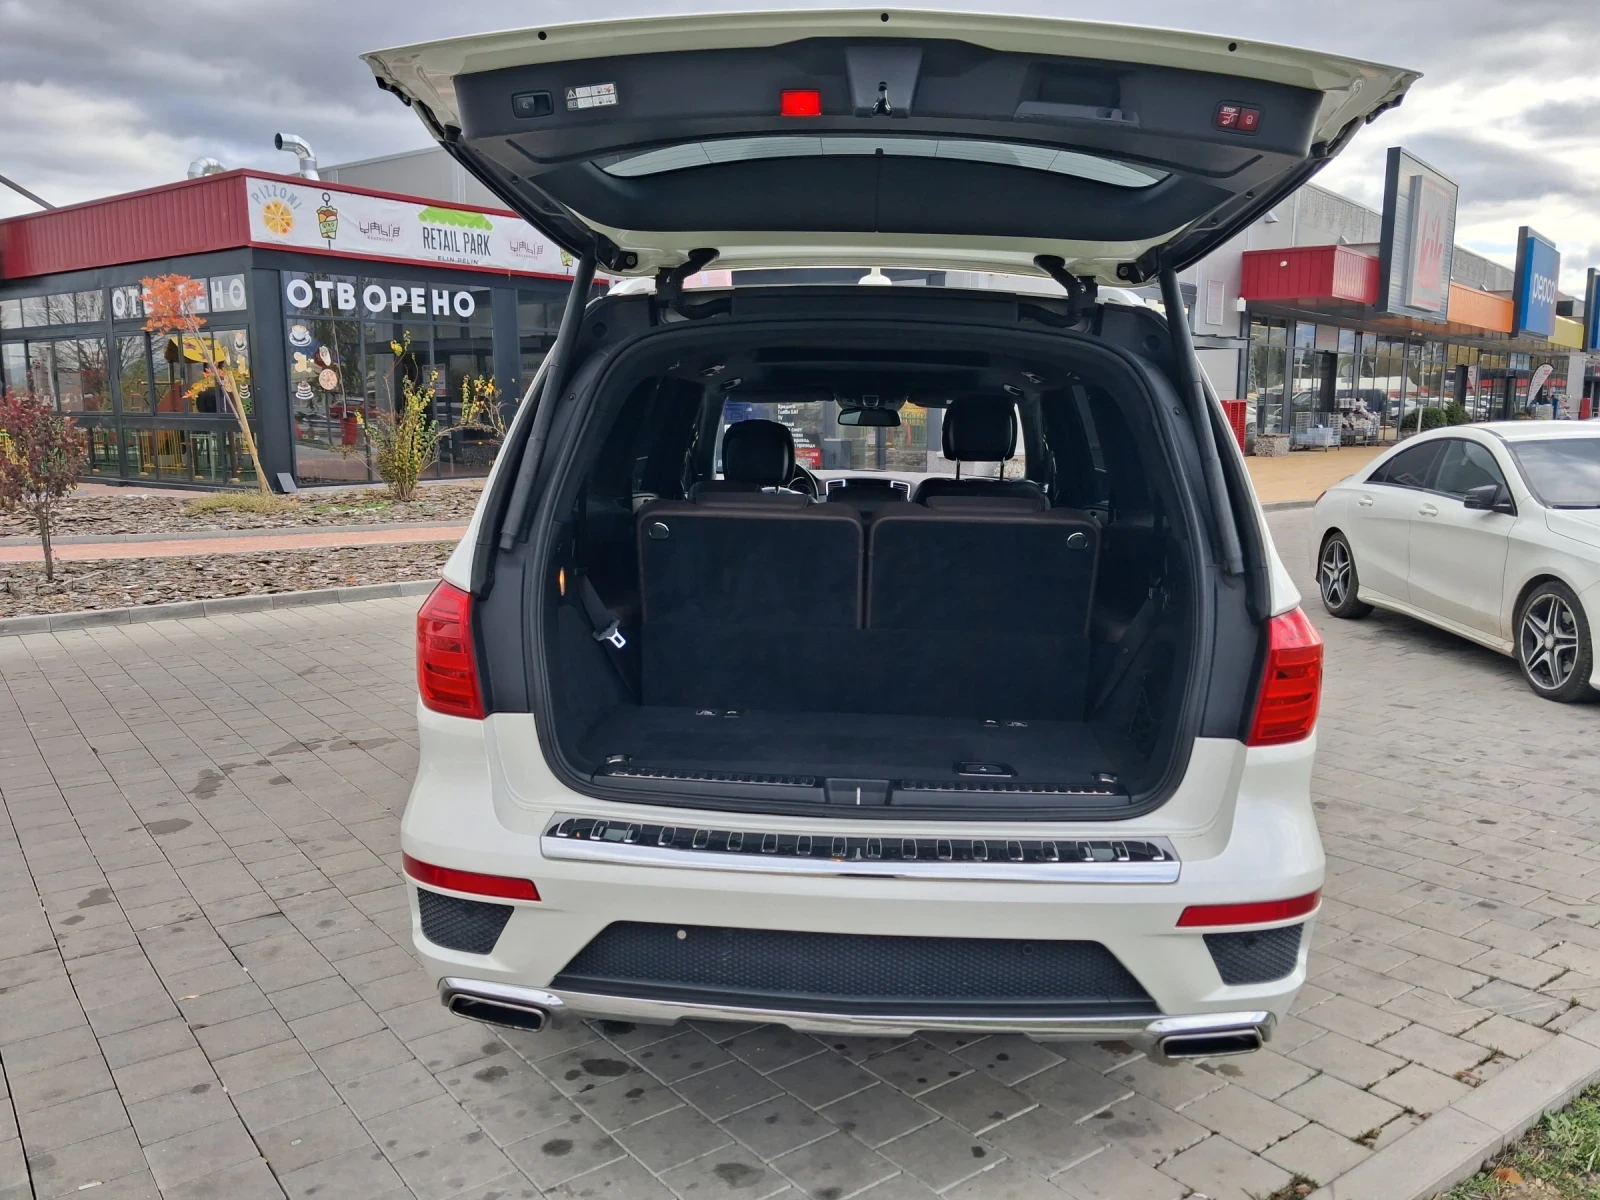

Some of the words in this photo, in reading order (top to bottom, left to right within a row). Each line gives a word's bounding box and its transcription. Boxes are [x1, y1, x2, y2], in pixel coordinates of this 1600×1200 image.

[251, 184, 303, 210] PIZZONI
[422, 226, 461, 253] RETAIL
[463, 232, 491, 257] PARK
[457, 257, 479, 265] PELIN
[286, 279, 475, 317] ОТВОРЕНО
[1531, 272, 1557, 308] pepco
